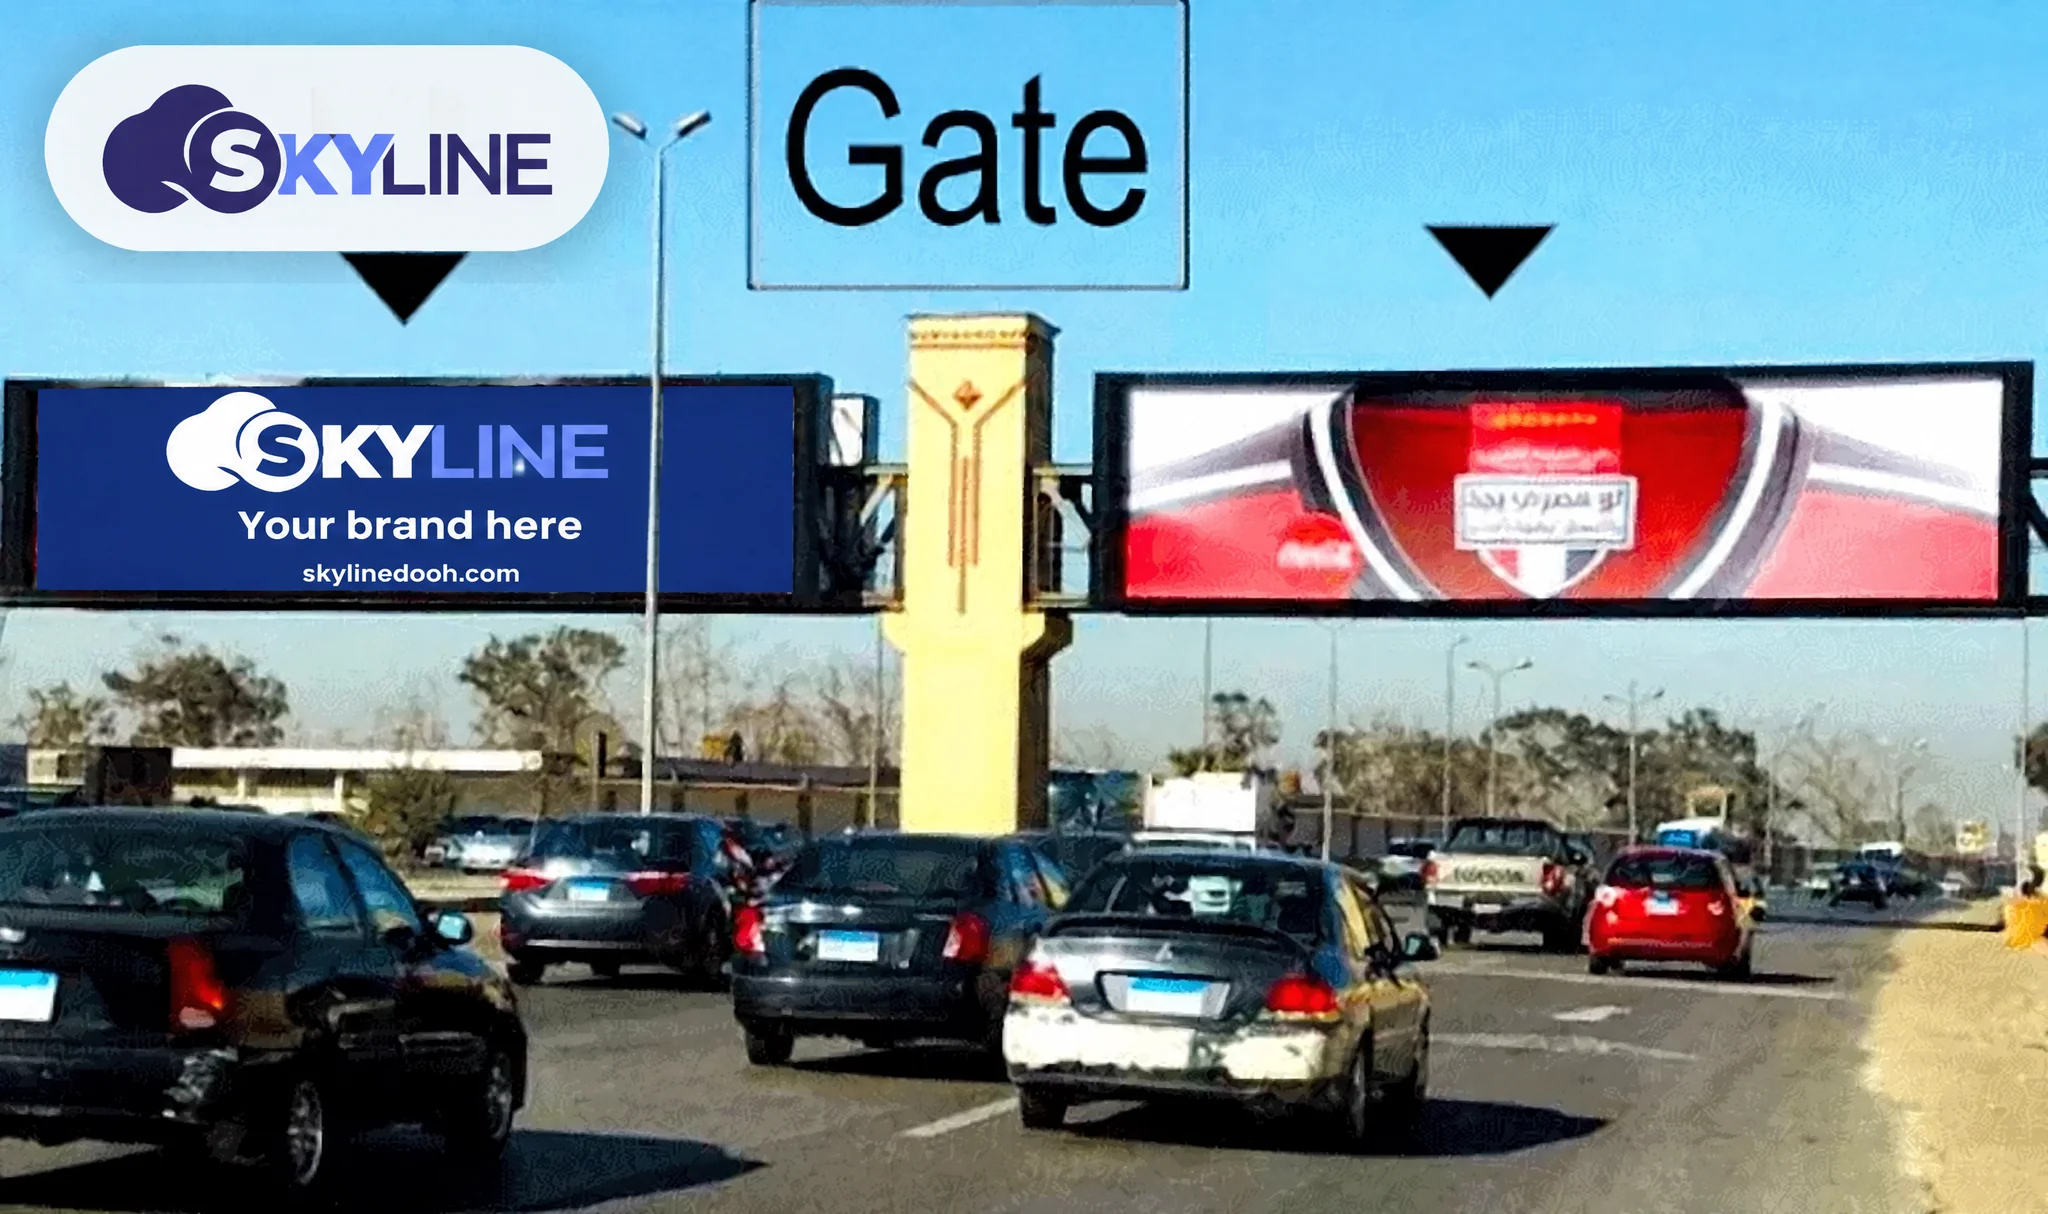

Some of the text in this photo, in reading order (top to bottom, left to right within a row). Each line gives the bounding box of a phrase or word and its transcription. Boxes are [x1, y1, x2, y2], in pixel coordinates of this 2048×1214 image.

[786, 68, 1148, 227] Gate
[255, 423, 609, 480] SKYLINE
[238, 509, 582, 540] Your brand here
[302, 563, 520, 587] skylinedooh.com
